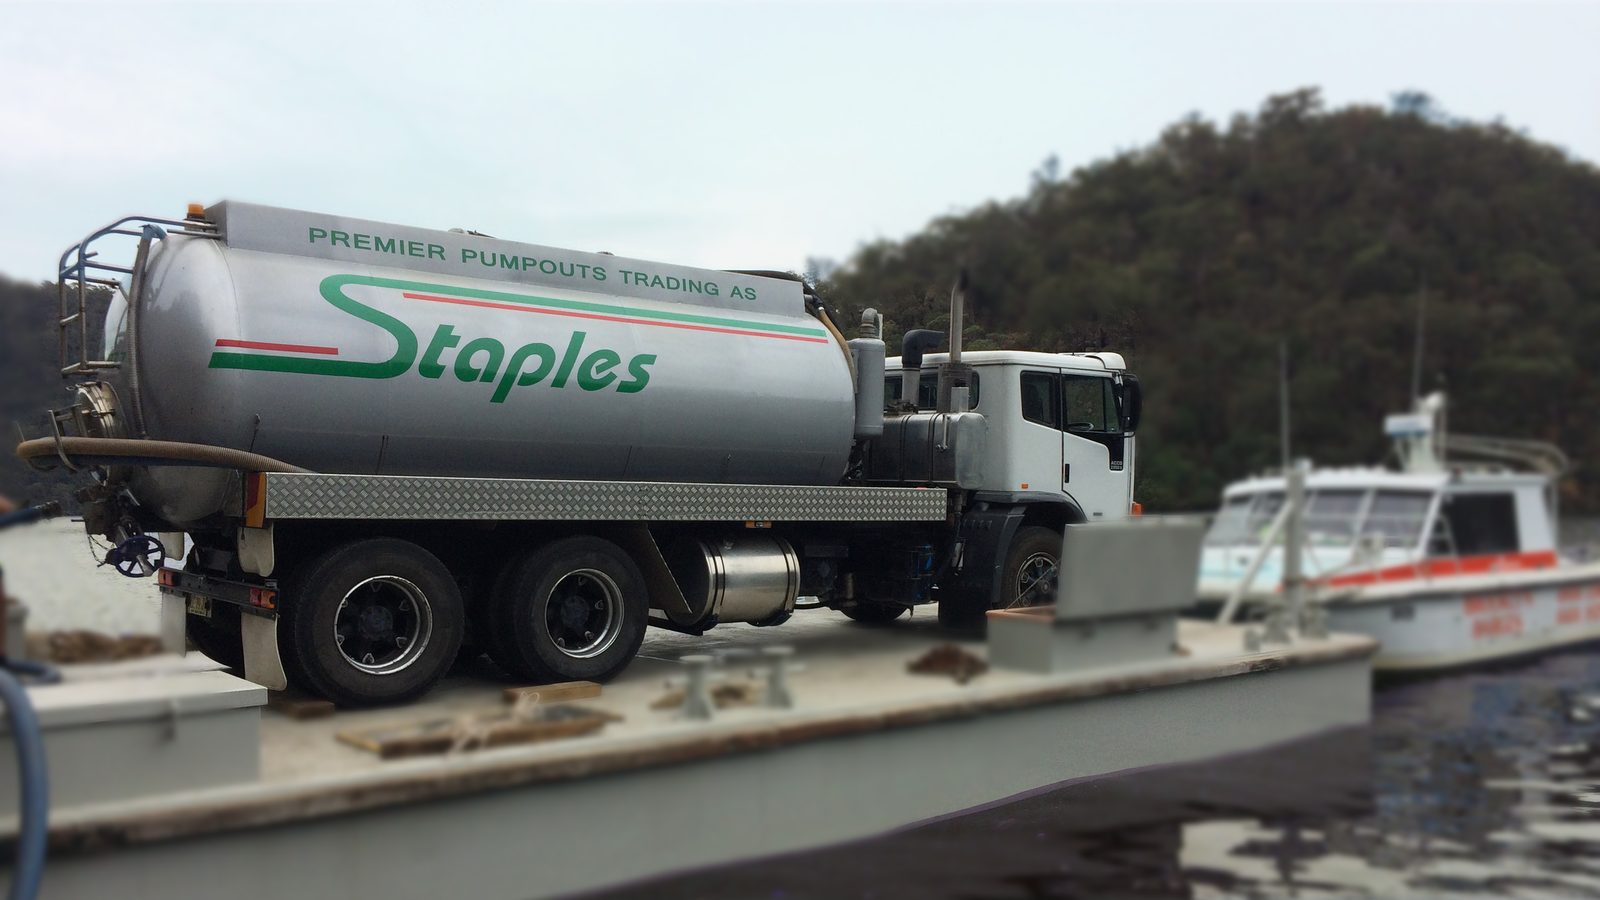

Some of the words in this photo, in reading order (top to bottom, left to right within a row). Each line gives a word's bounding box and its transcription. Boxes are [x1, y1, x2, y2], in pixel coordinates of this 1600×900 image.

[308, 227, 446, 260] PREMIER
[461, 248, 607, 281] PUMPOUTS
[619, 269, 719, 296] TRADING
[730, 285, 757, 301] AS
[208, 274, 657, 404] Staples
